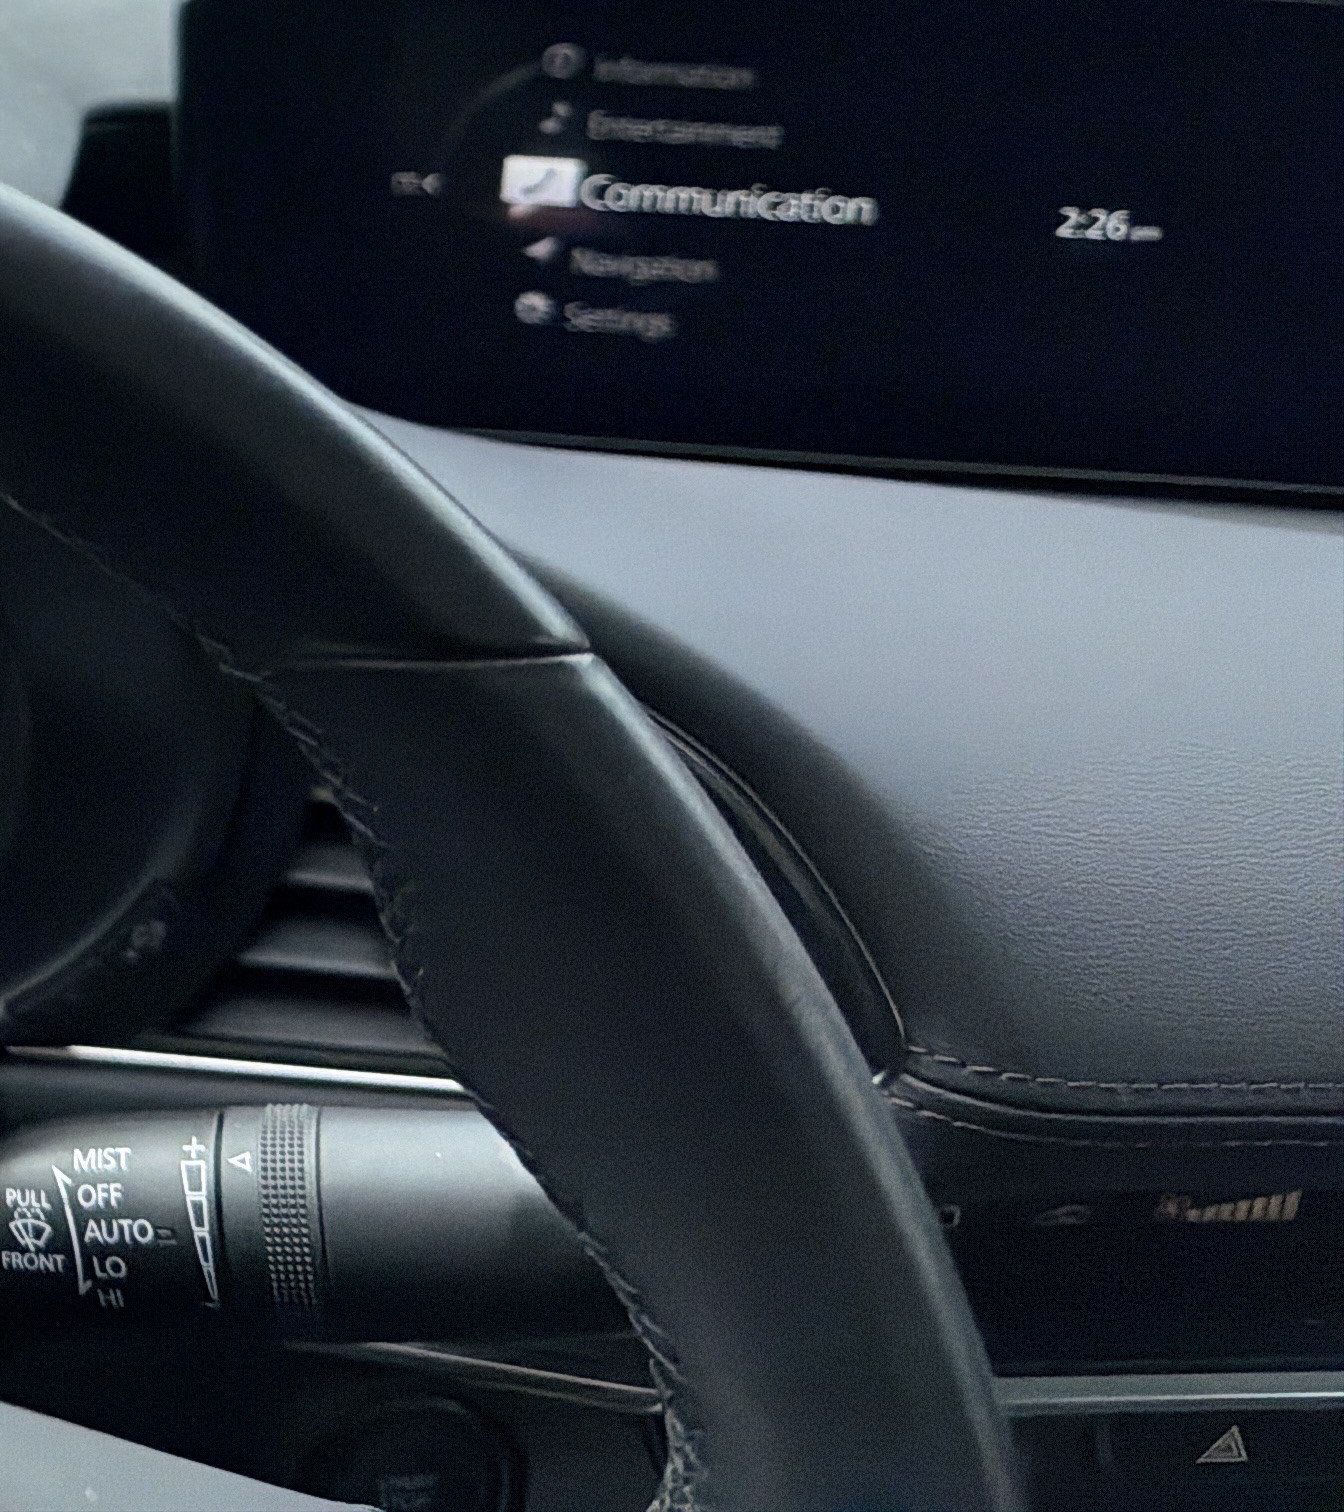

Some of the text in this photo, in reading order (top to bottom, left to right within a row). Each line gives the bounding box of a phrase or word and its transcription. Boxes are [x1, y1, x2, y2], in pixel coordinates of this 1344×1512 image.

[579, 173, 881, 227] Communication
[72, 1147, 132, 1173] MIST
[5, 1188, 52, 1210] PULL
[77, 1183, 123, 1209] OFF
[83, 1218, 155, 1245] AUTO
[1, 1250, 65, 1274] FRONT
[92, 1256, 128, 1279] LO
[97, 1287, 125, 1308] HI
